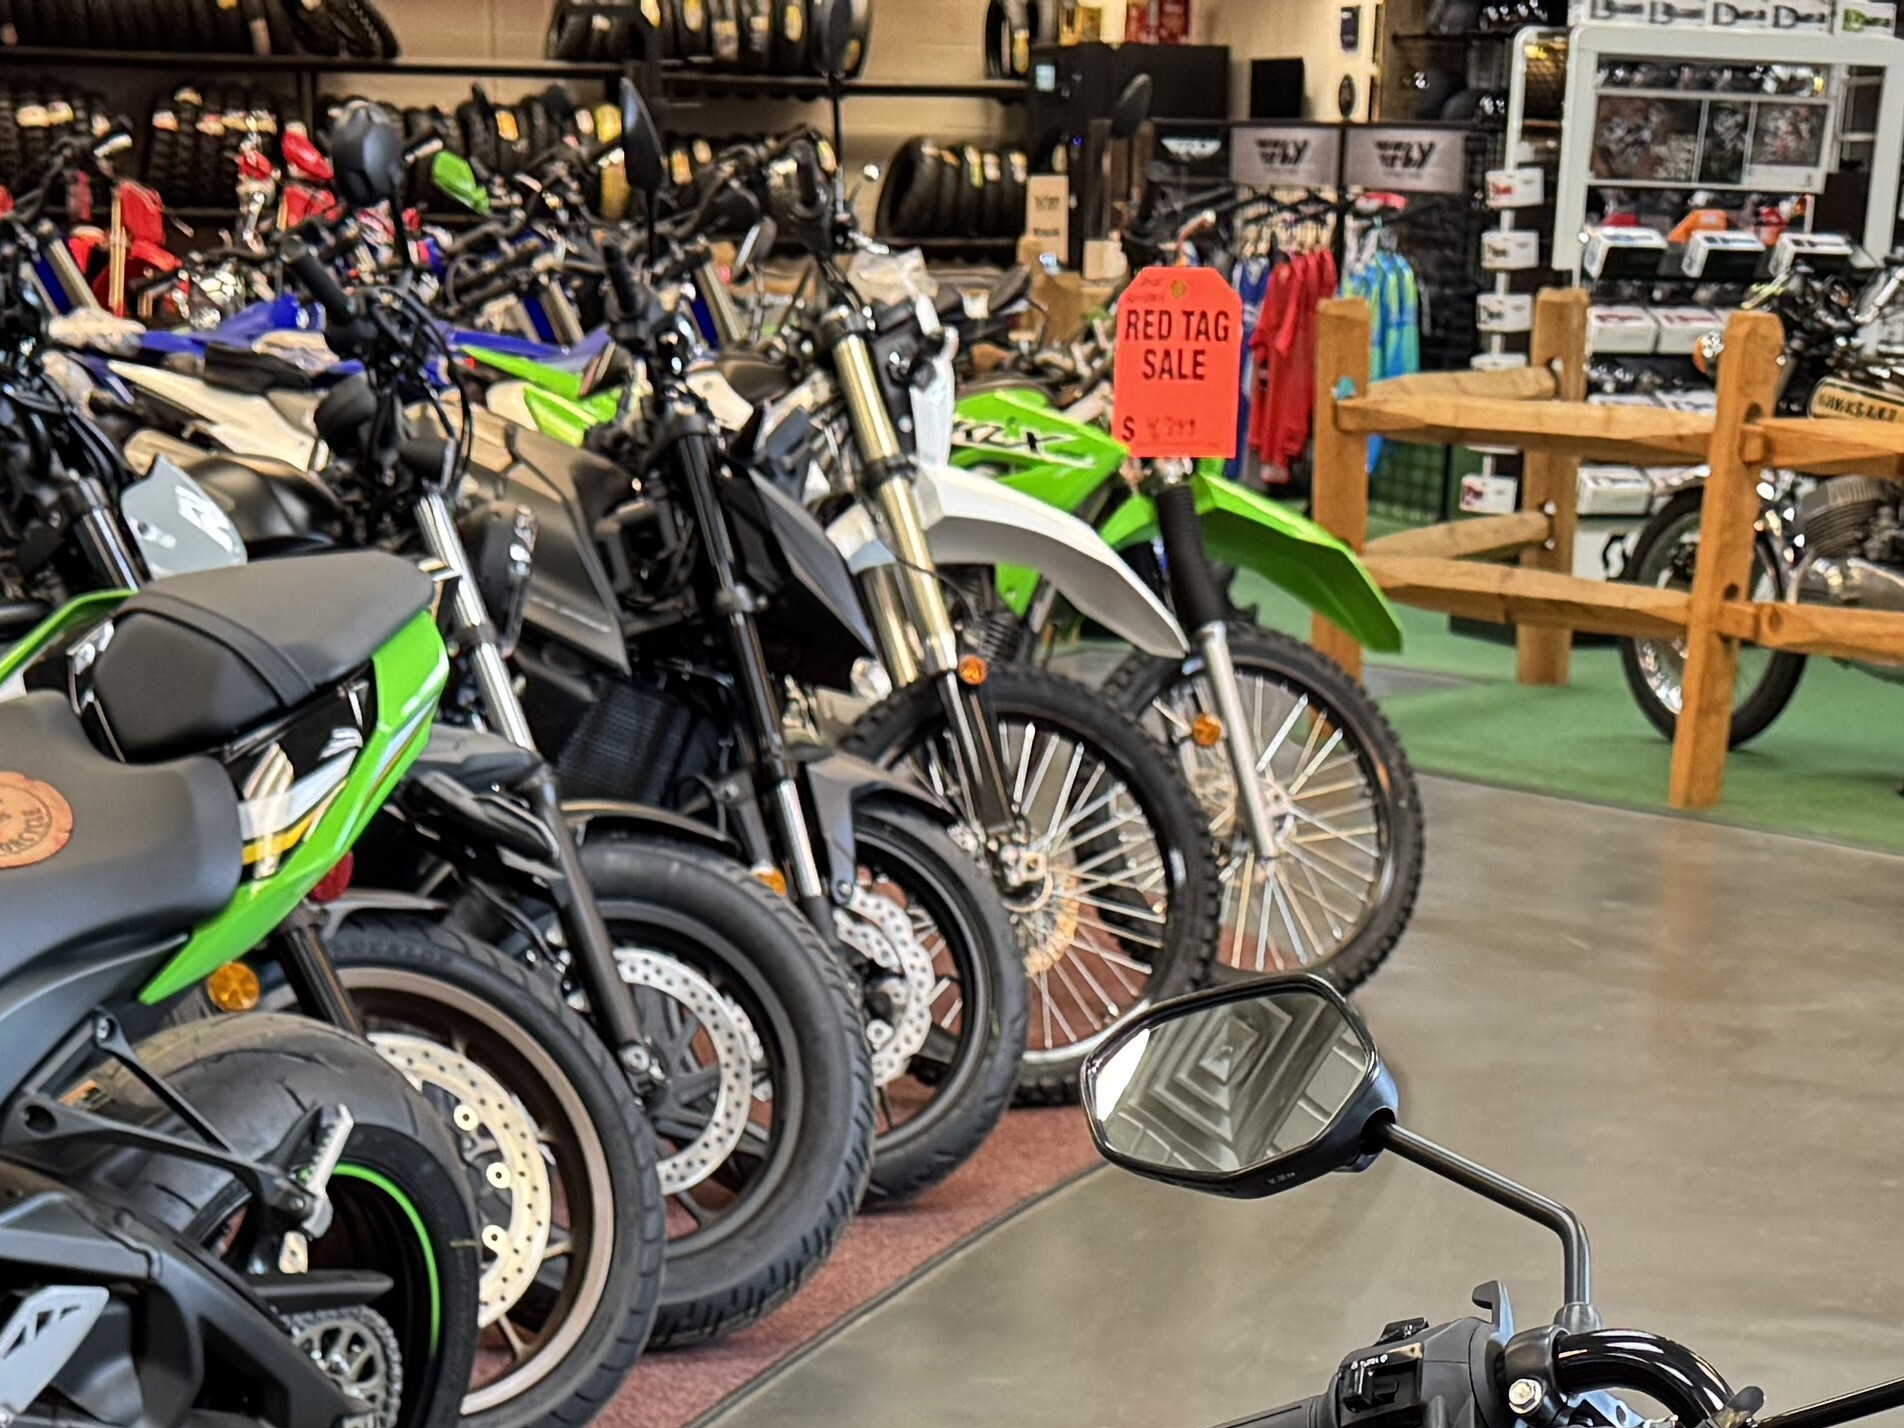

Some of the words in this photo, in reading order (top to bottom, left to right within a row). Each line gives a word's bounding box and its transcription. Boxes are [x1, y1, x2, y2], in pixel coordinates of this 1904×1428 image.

[1124, 308, 1173, 342] RED
[1181, 309, 1230, 342] TAG
[1142, 347, 1207, 381] SALE
